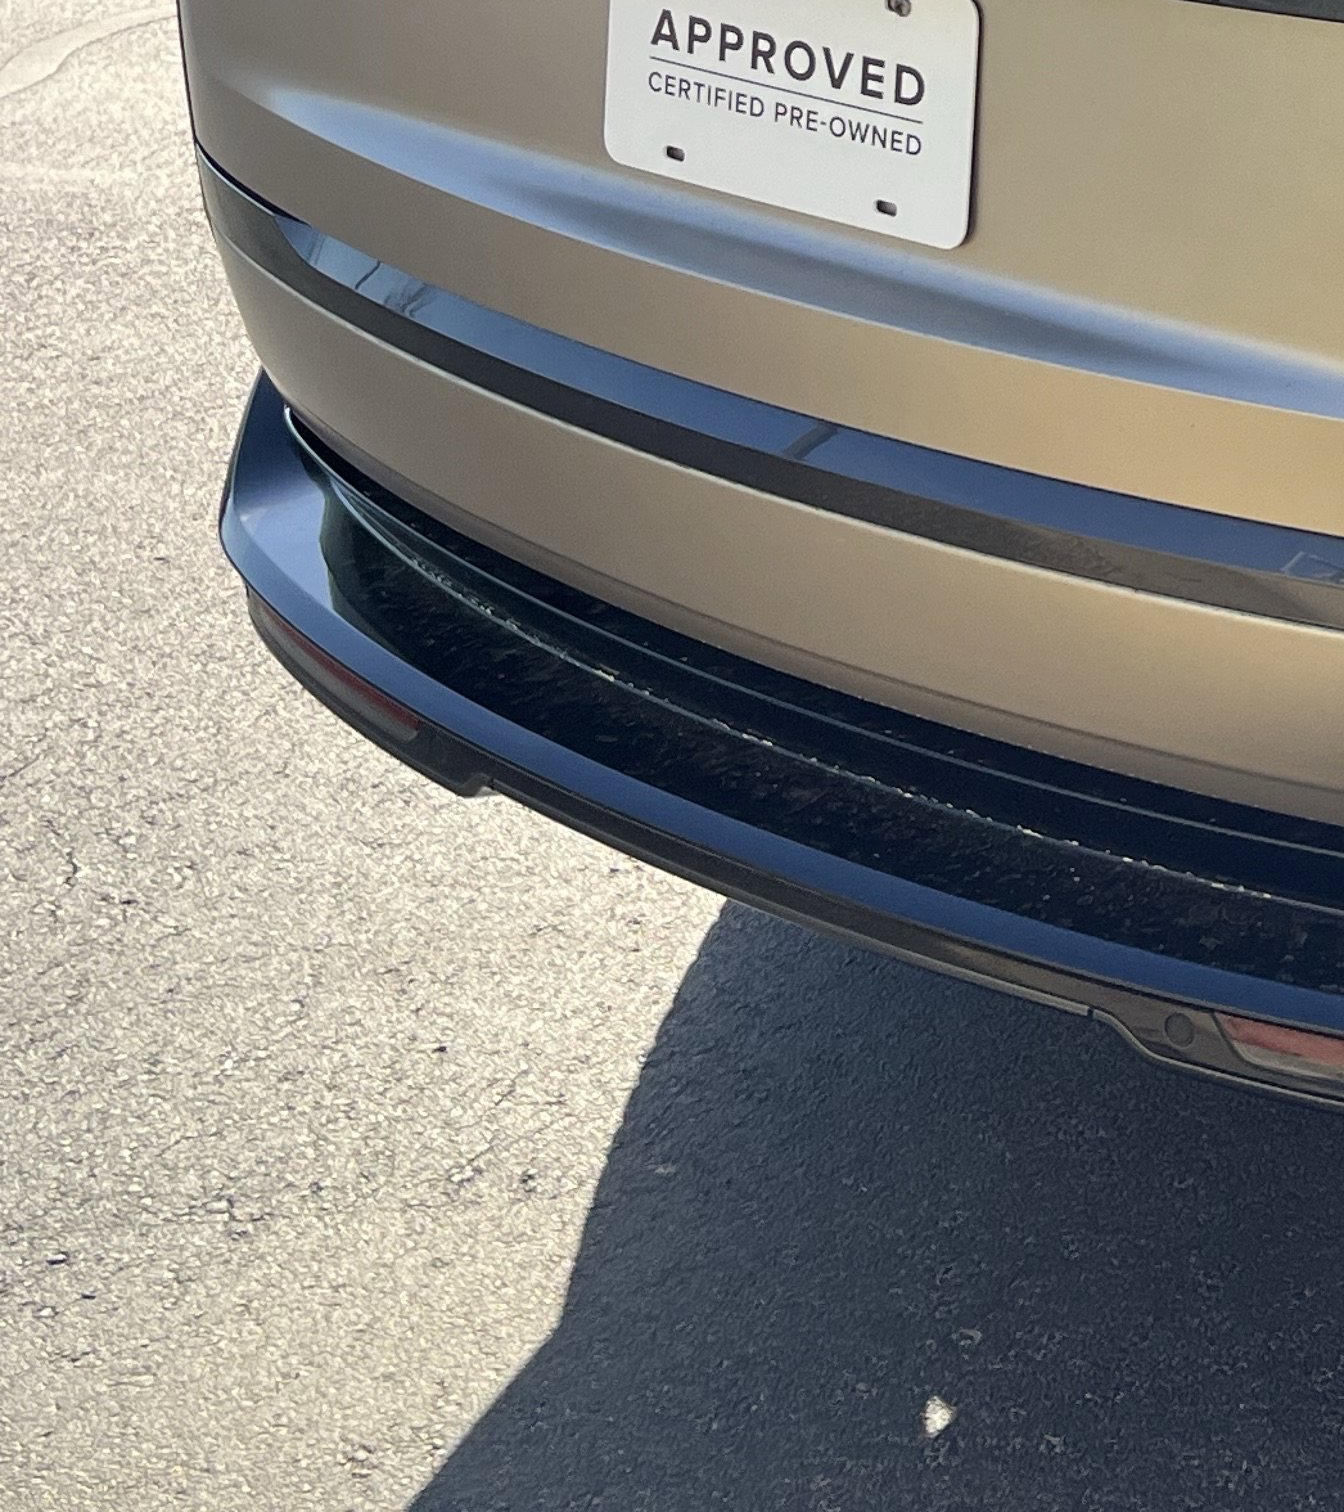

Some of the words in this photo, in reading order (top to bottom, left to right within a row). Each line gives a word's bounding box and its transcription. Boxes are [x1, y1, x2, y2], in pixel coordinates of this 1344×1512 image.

[650, 8, 926, 106] APPROVED
[648, 71, 765, 118] CERTIFIED
[774, 101, 923, 156] PRE-OWNED
